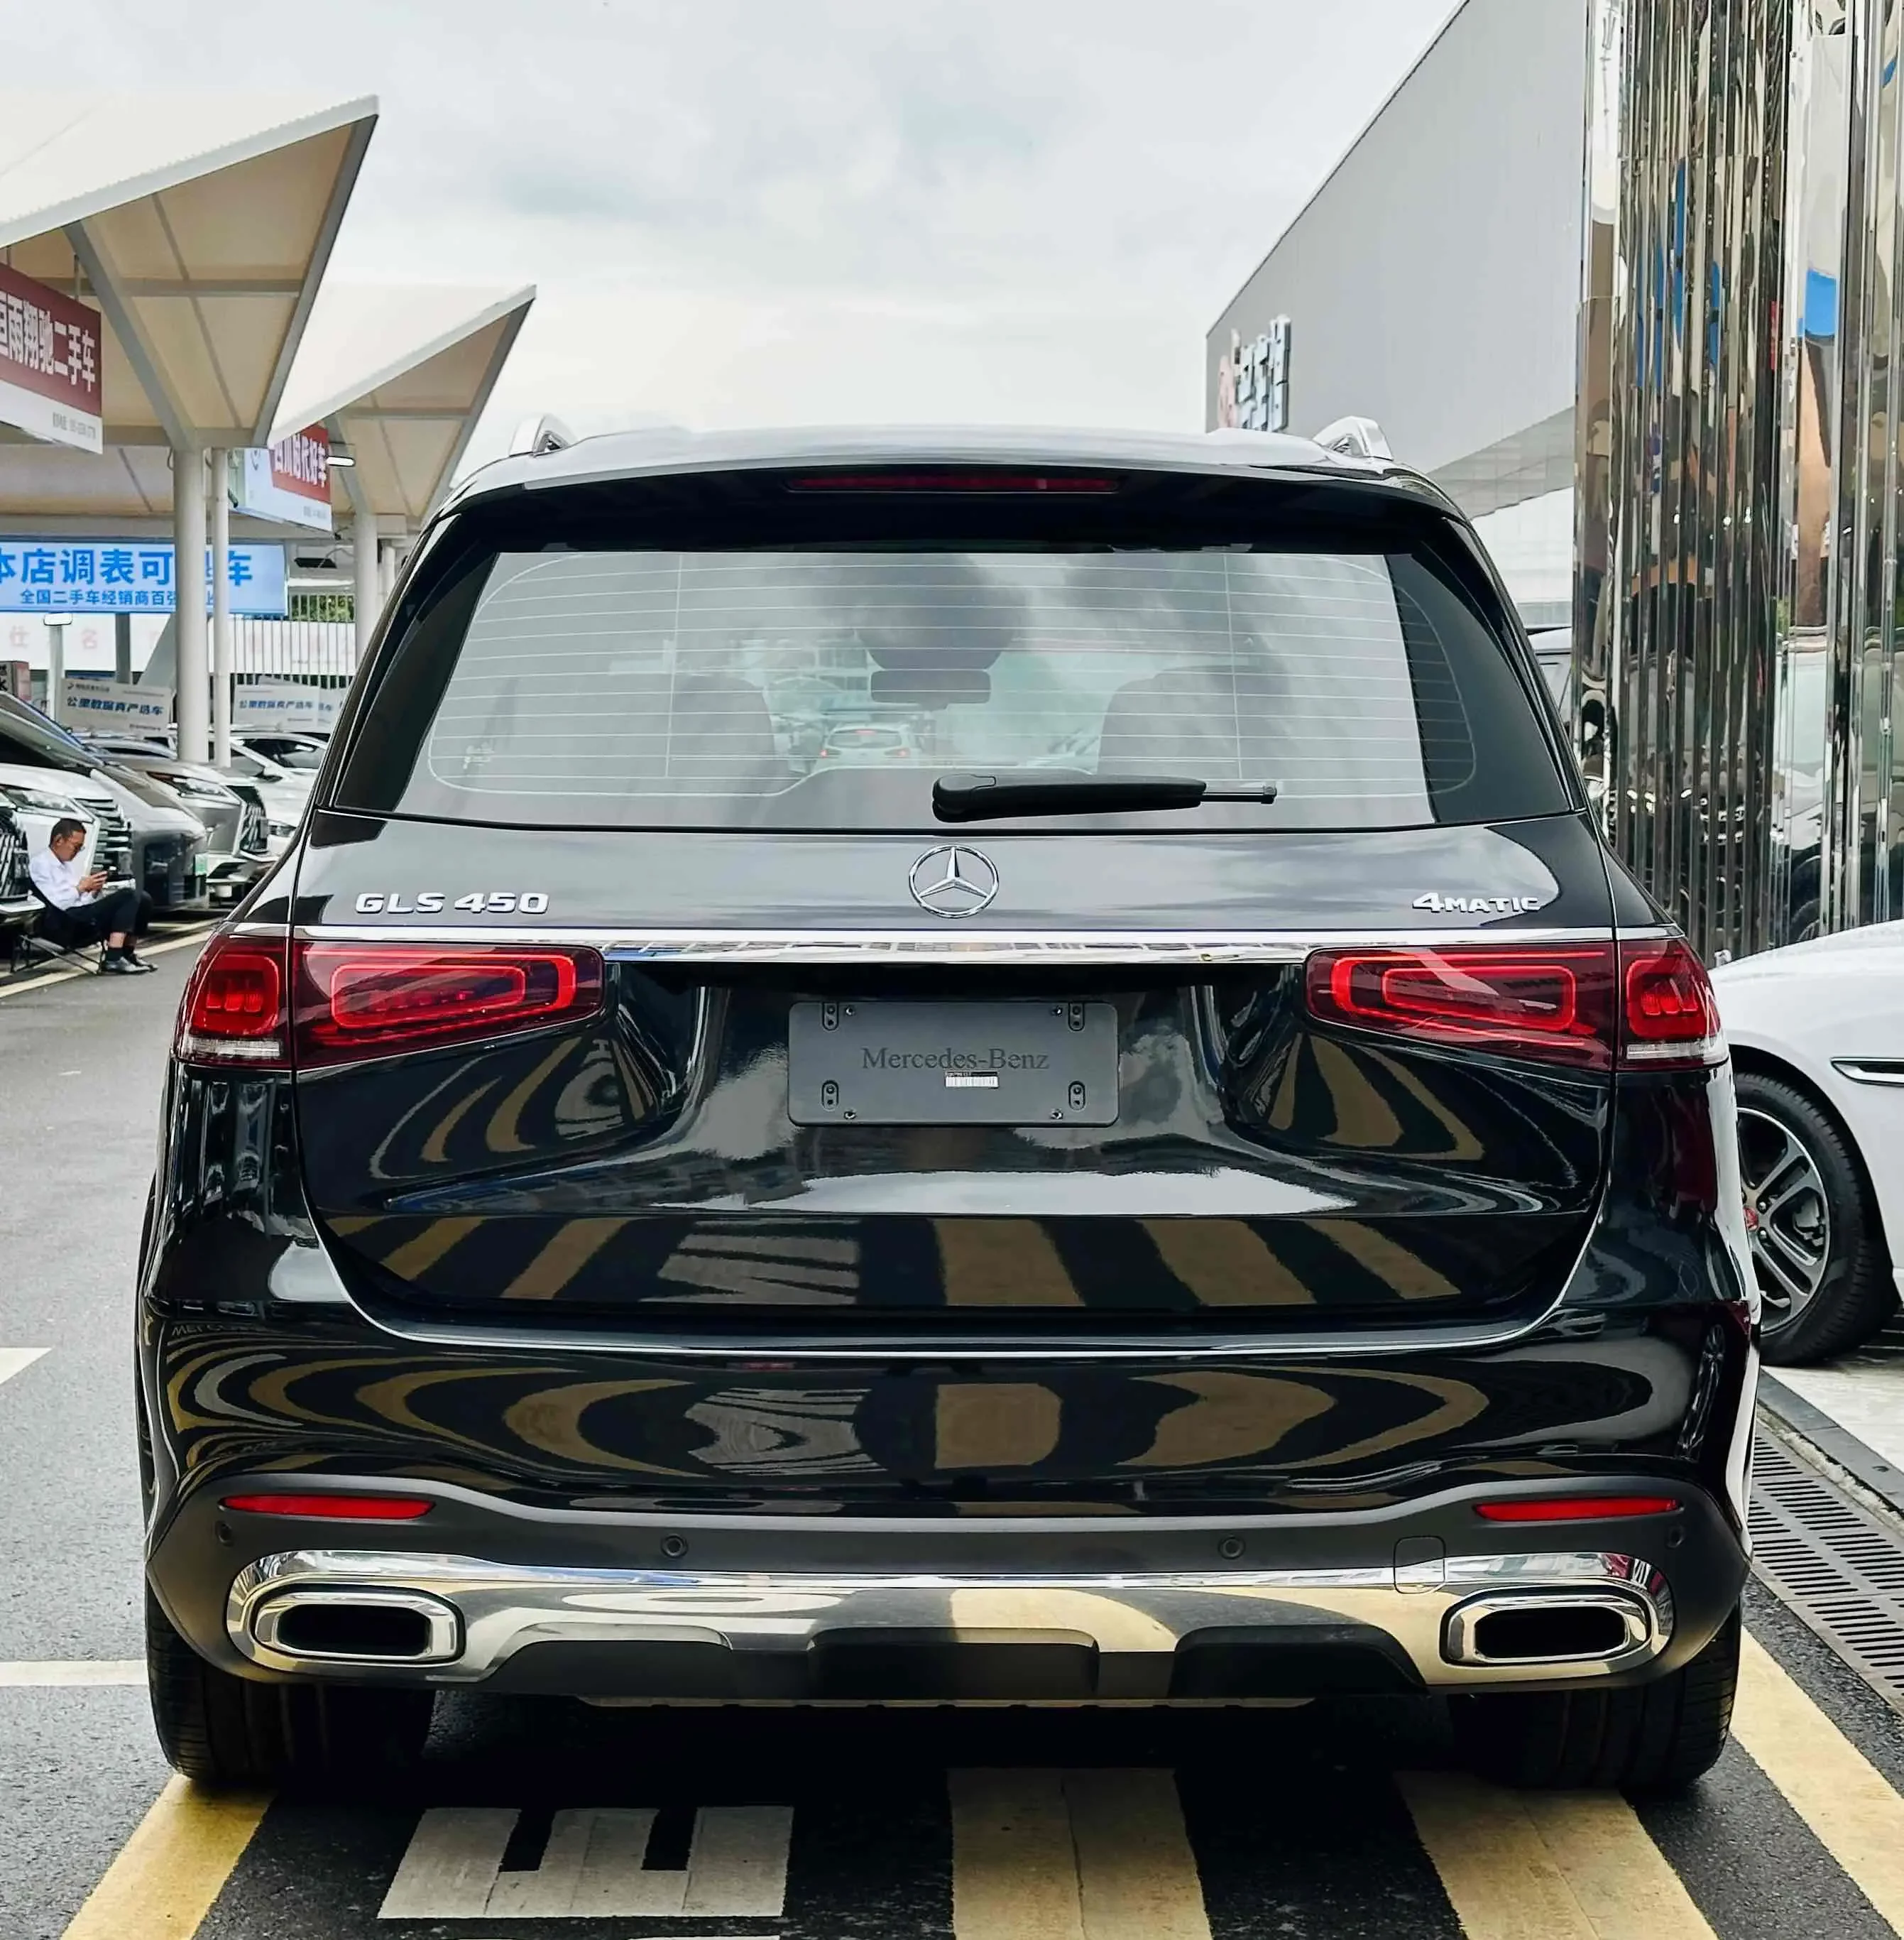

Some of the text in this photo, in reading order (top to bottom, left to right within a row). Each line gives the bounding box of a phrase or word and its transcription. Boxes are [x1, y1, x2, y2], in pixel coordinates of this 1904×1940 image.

[0, 547, 253, 587] 本店调表可车
[355, 892, 549, 915] GLS 450
[1411, 891, 1542, 914] 4MATIC
[860, 1047, 1050, 1070] Mercedes-Benz
